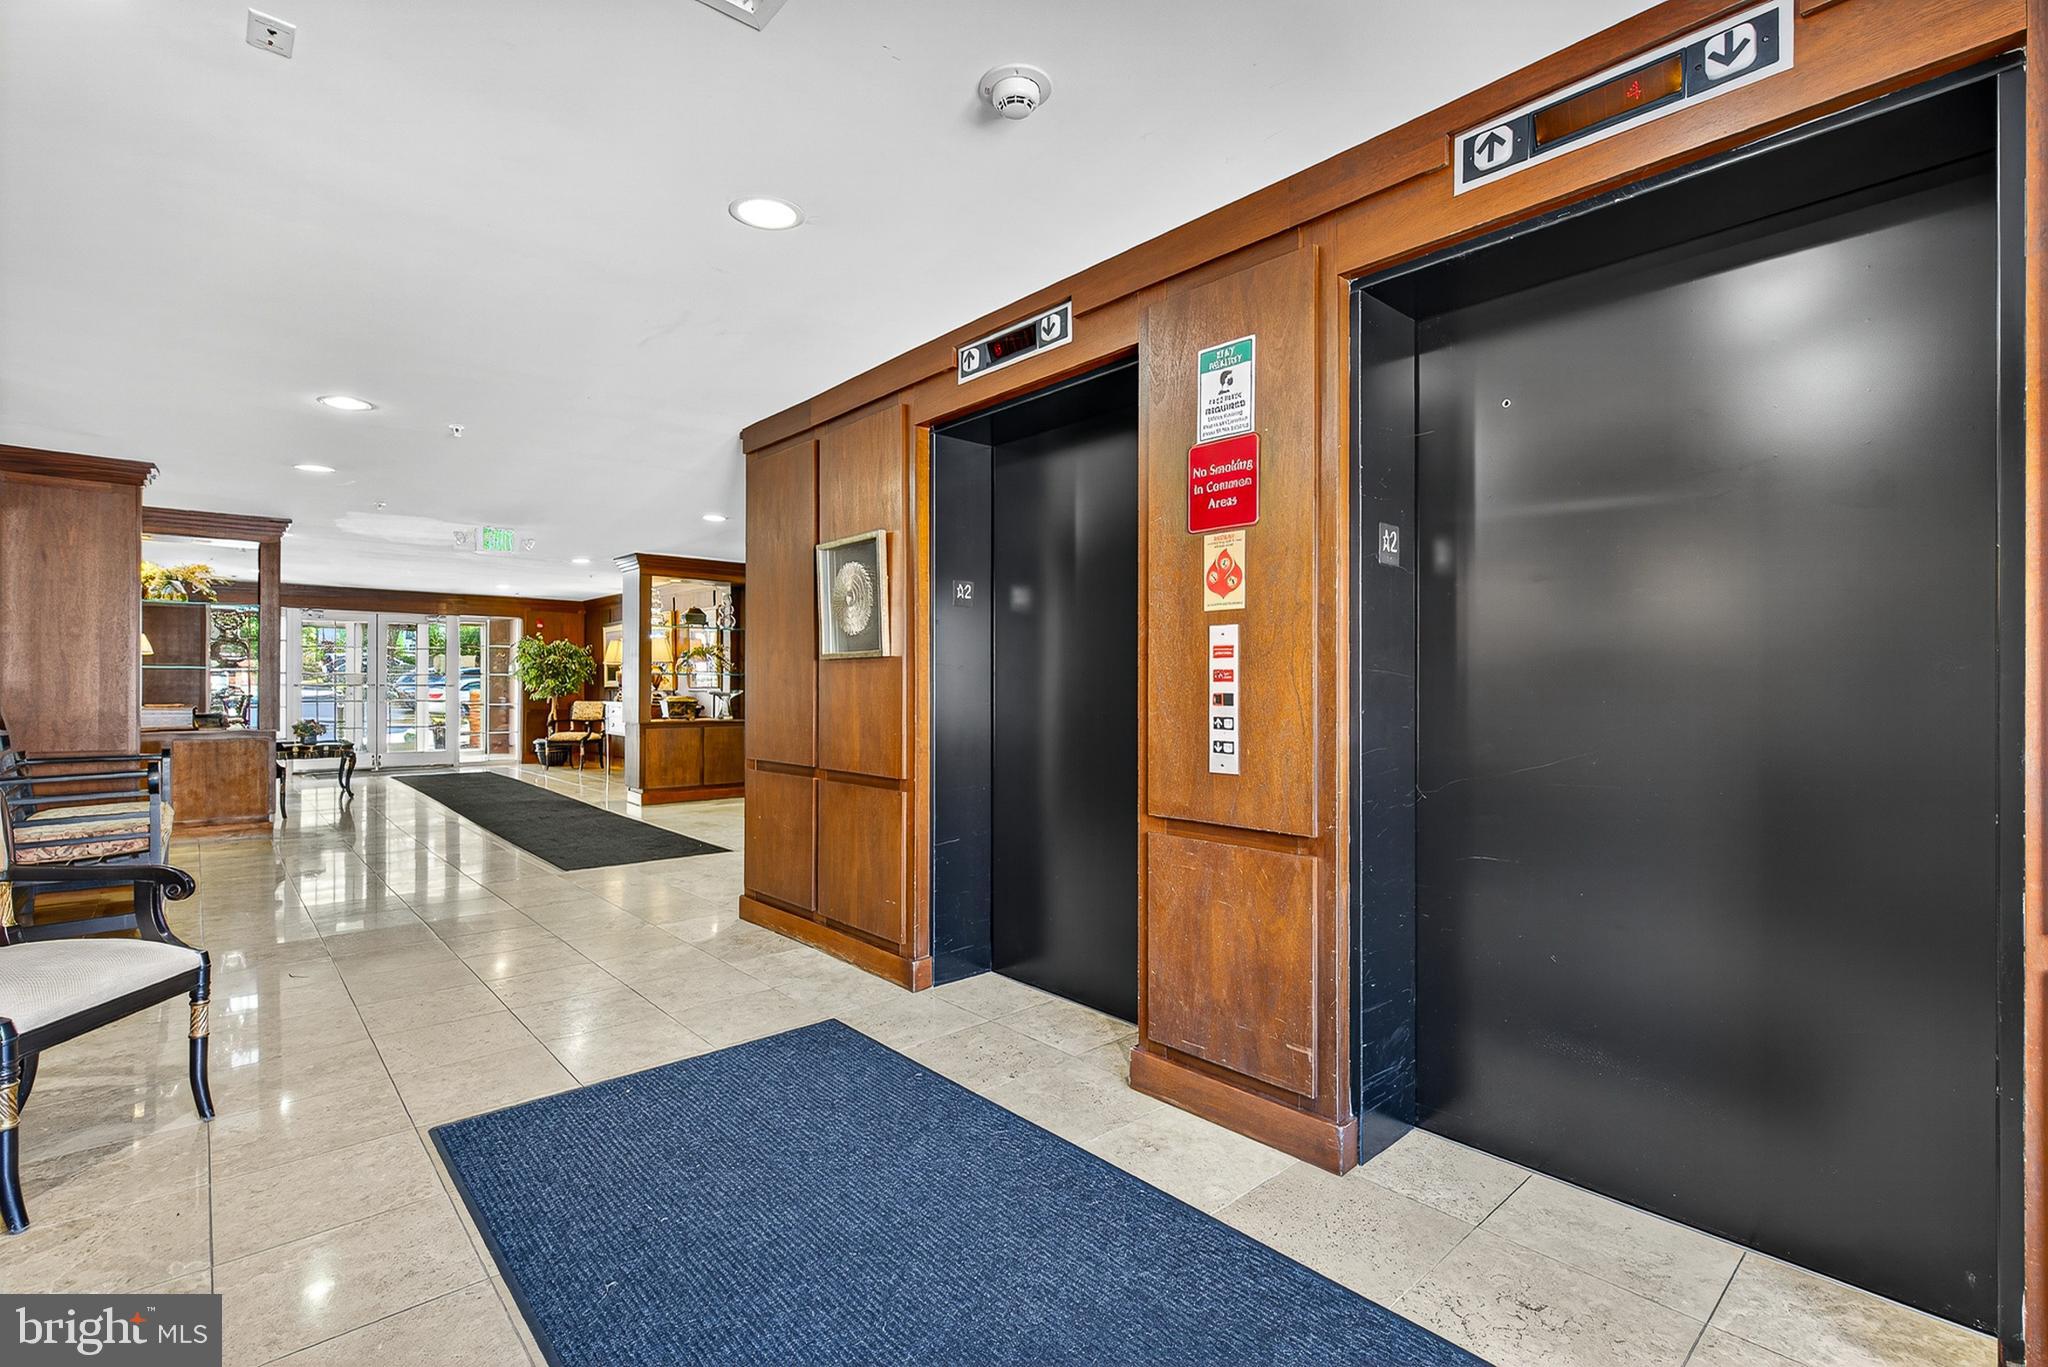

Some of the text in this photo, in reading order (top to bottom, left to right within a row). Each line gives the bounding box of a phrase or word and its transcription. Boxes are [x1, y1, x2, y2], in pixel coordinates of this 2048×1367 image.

[1193, 459, 1253, 479] No Smoking
[1194, 477, 1252, 495] In Common
[1208, 496, 1238, 509] Areas
